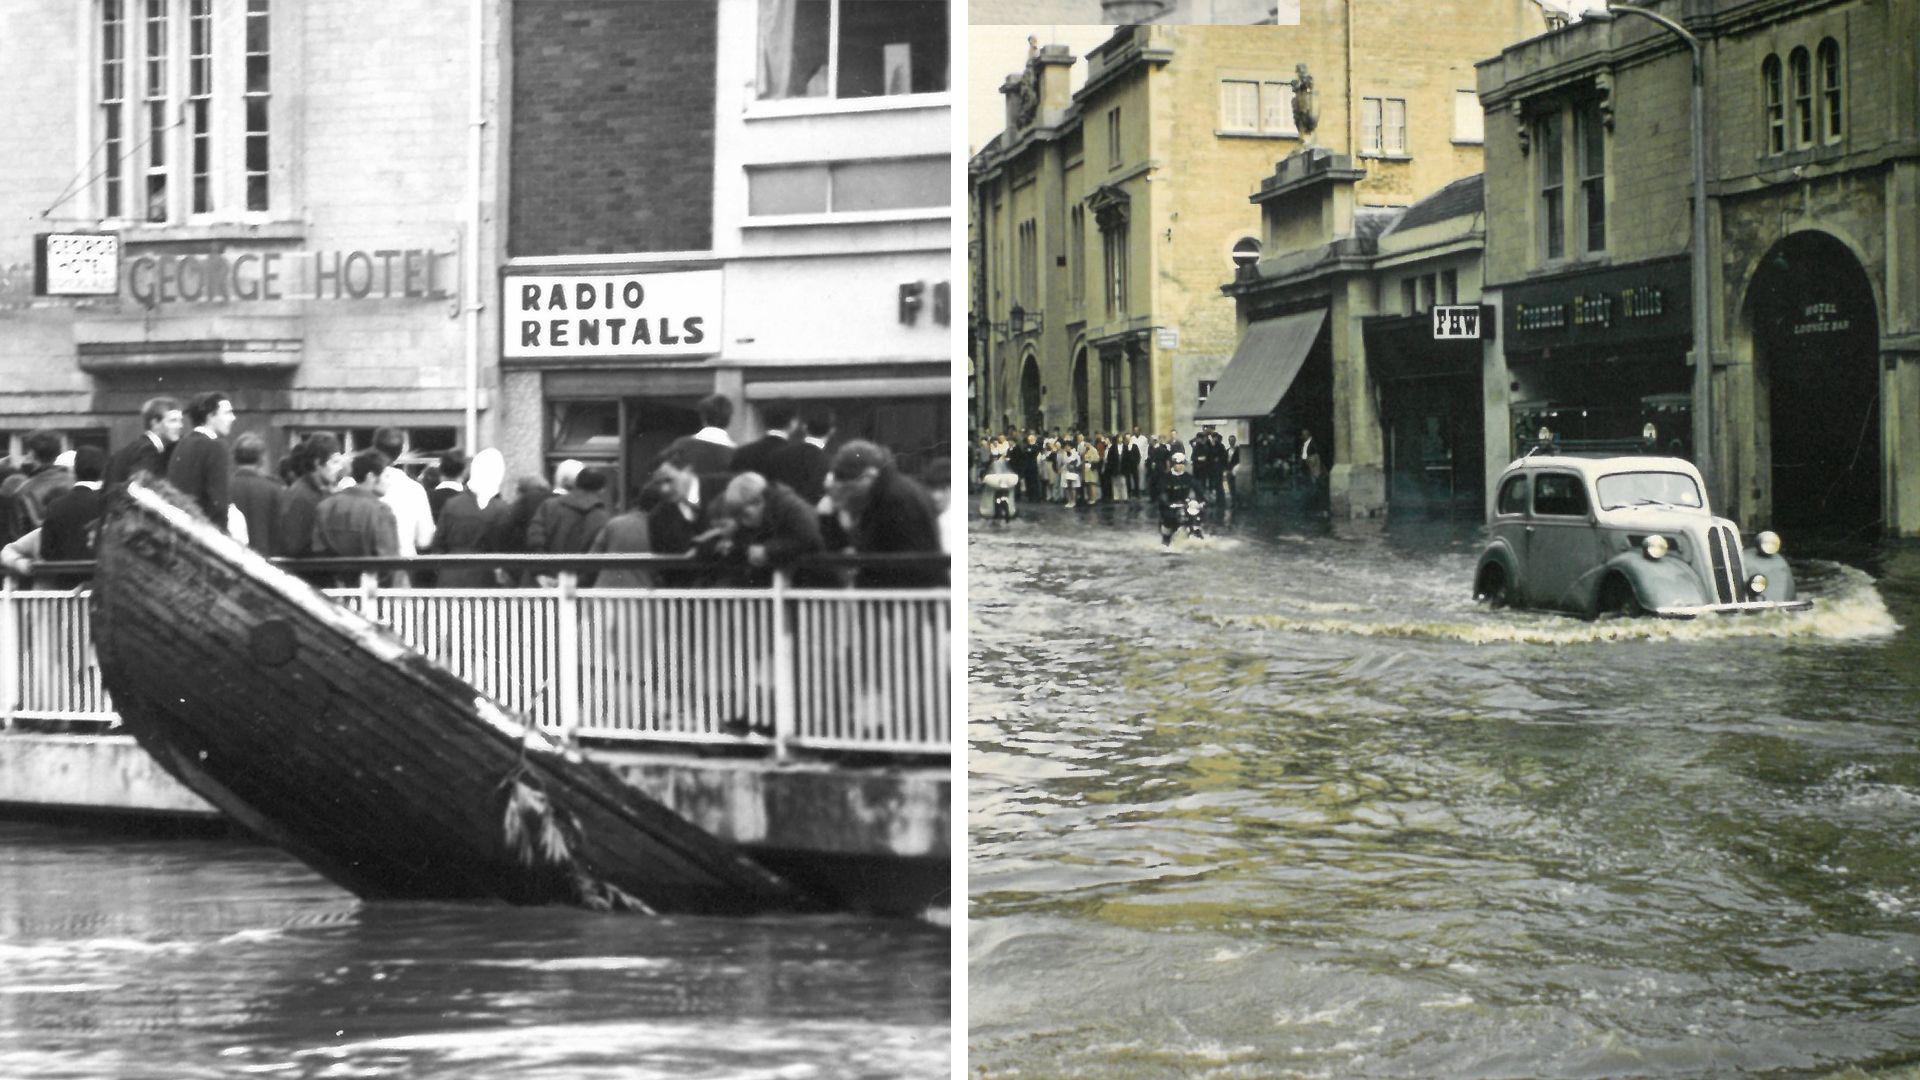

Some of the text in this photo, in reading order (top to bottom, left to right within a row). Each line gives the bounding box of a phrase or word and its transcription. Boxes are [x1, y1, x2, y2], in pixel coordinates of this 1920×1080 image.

[129, 250, 448, 304] GEORGE HOTEL
[521, 281, 645, 311] RADIO
[521, 316, 704, 347] RENTALS
